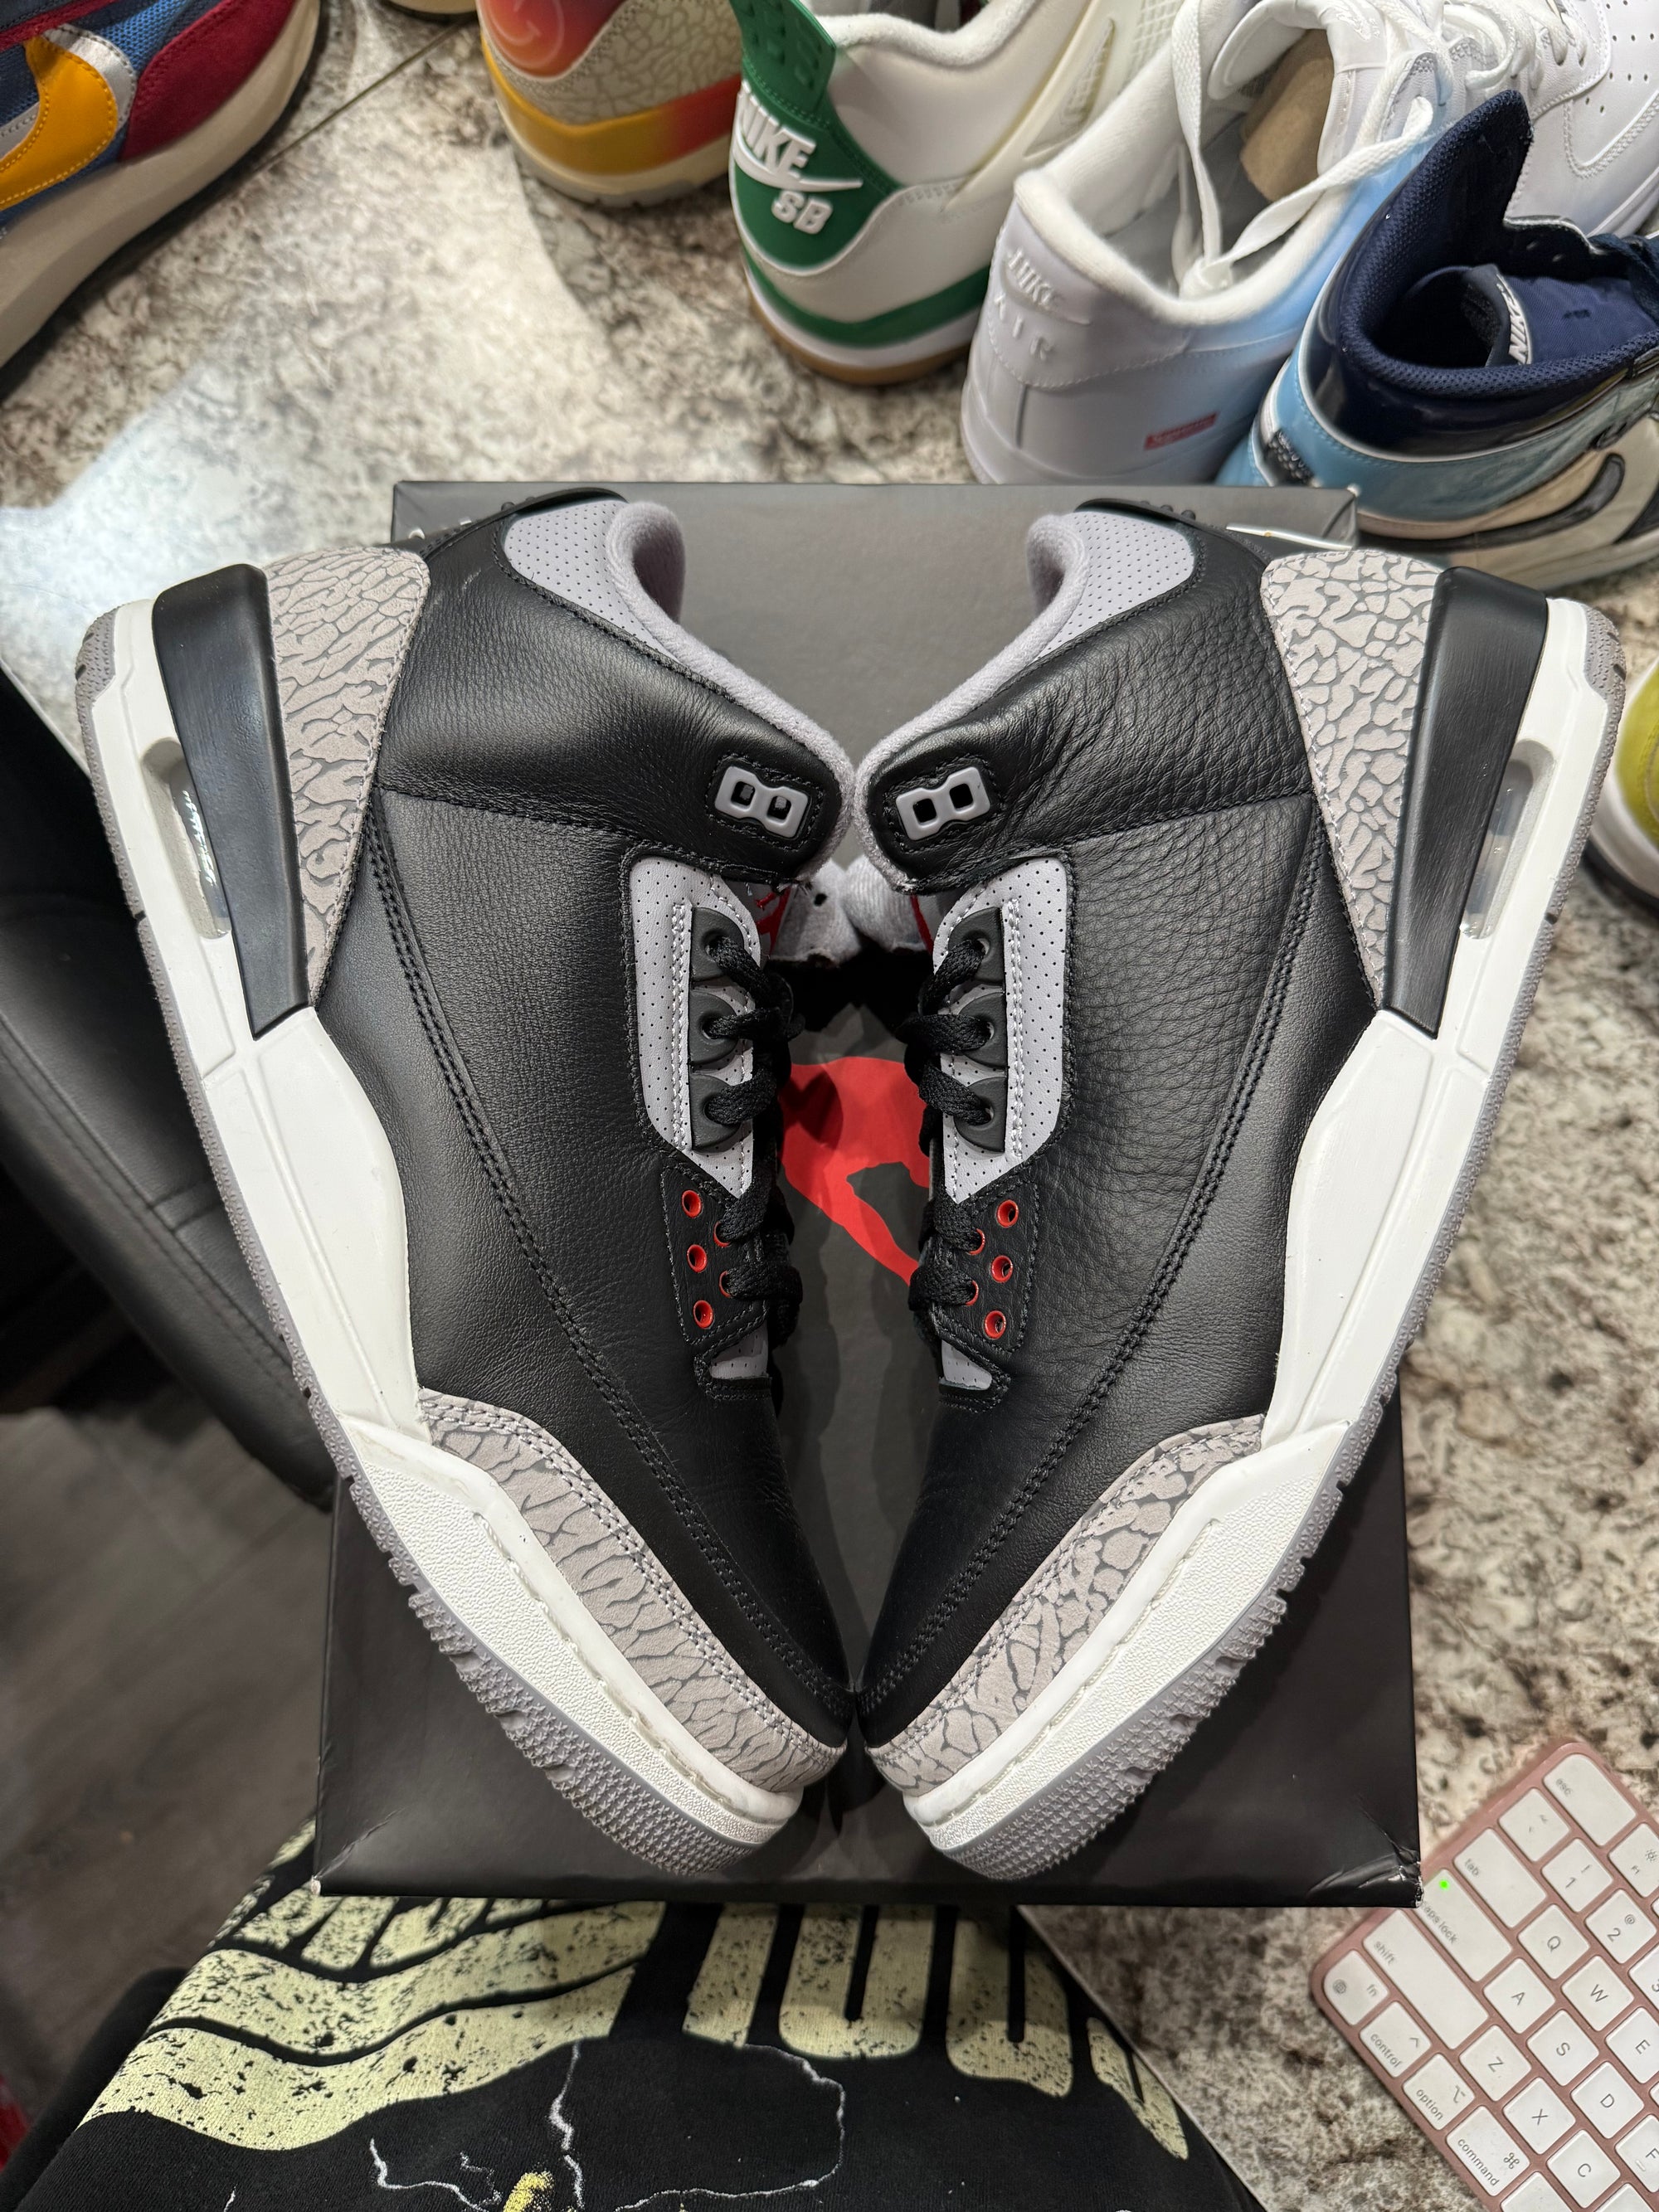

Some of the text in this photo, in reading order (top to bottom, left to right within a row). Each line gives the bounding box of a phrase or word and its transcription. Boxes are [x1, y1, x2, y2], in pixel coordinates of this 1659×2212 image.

[736, 80, 817, 179] NIKE
[771, 190, 833, 235] SB
[1555, 1778, 1574, 1796] esc
[1464, 1858, 1481, 1878] tab
[1564, 1877, 1577, 1890] 1
[1438, 1920, 1459, 1944] lock
[1607, 1927, 1622, 1942] 2
[1373, 1941, 1396, 1965] shift
[1547, 1935, 1562, 1953] Q
[1366, 1983, 1378, 1998] fn
[1511, 1991, 1526, 2006] A
[1589, 1983, 1609, 2003] W
[1370, 2033, 1403, 2069] control
[1555, 2041, 1571, 2057] S
[1634, 2039, 1652, 2055] E
[1487, 2055, 1504, 2073] Z
[1415, 2088, 1444, 2122] option
[1599, 2093, 1616, 2109] D
[1531, 2107, 1549, 2126] X
[1645, 2147, 1659, 2159] F
[1457, 2138, 1500, 2187] command
[1577, 2162, 1592, 2178] C
